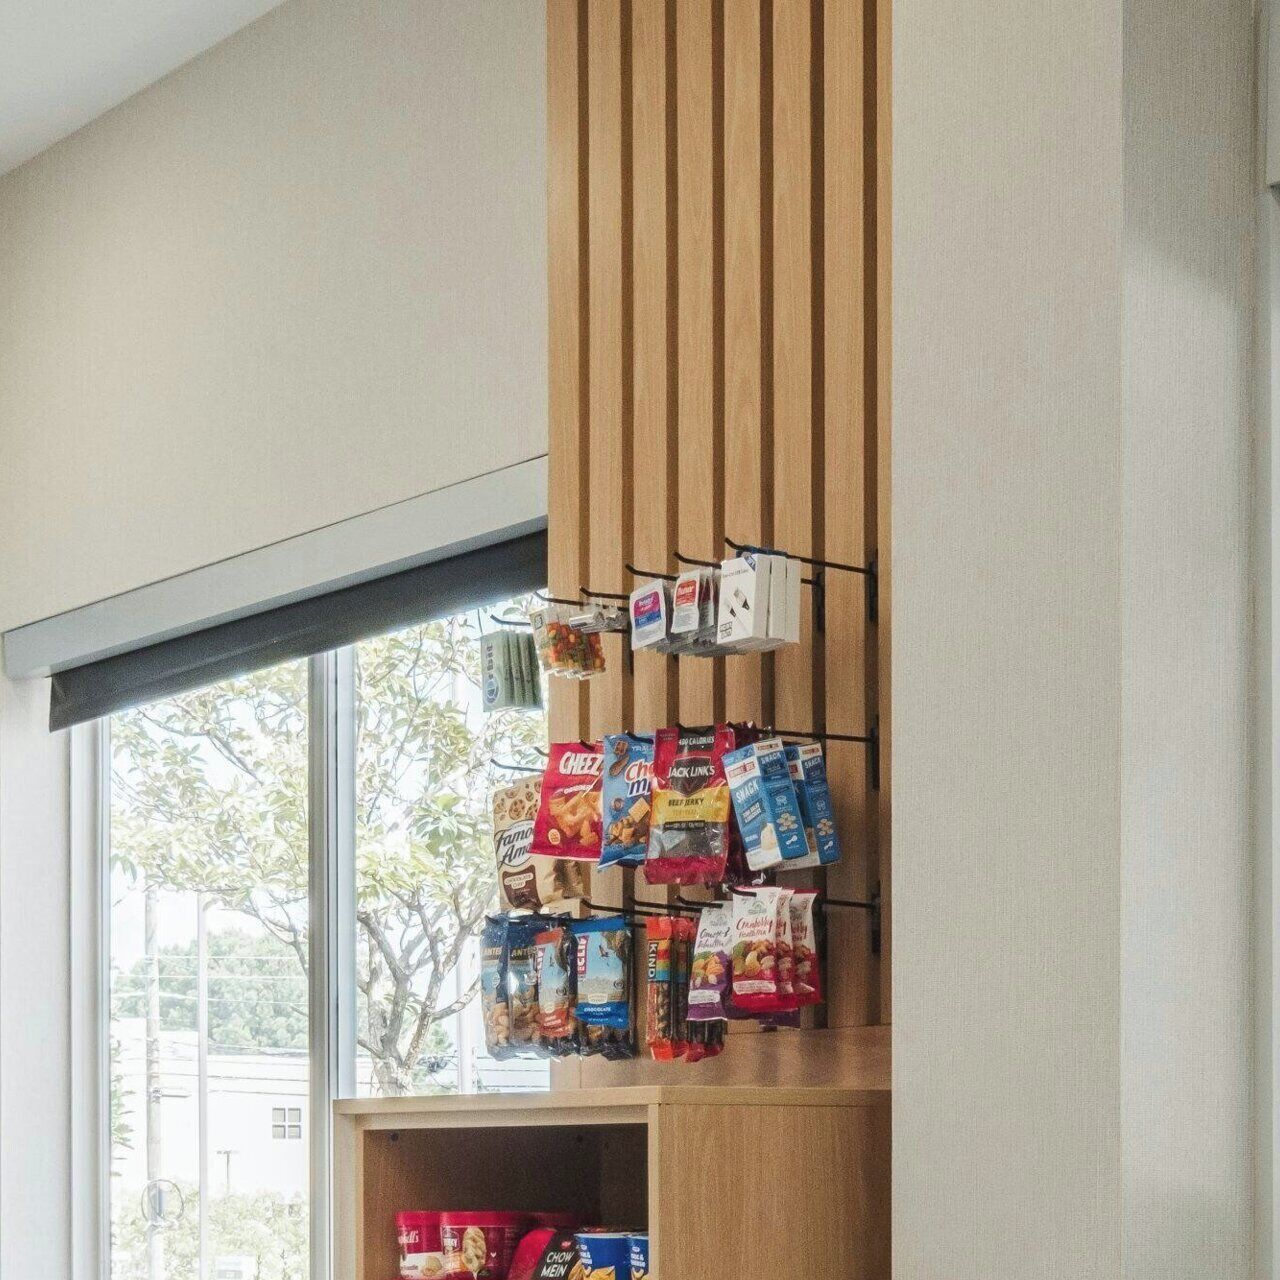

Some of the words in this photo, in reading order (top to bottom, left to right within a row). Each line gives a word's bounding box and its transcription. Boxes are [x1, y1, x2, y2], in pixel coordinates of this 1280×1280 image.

[494, 827, 534, 855] Famo
[648, 944, 656, 977] KIND
[546, 1251, 574, 1263] CHOW
[540, 1264, 568, 1277] MEIN
